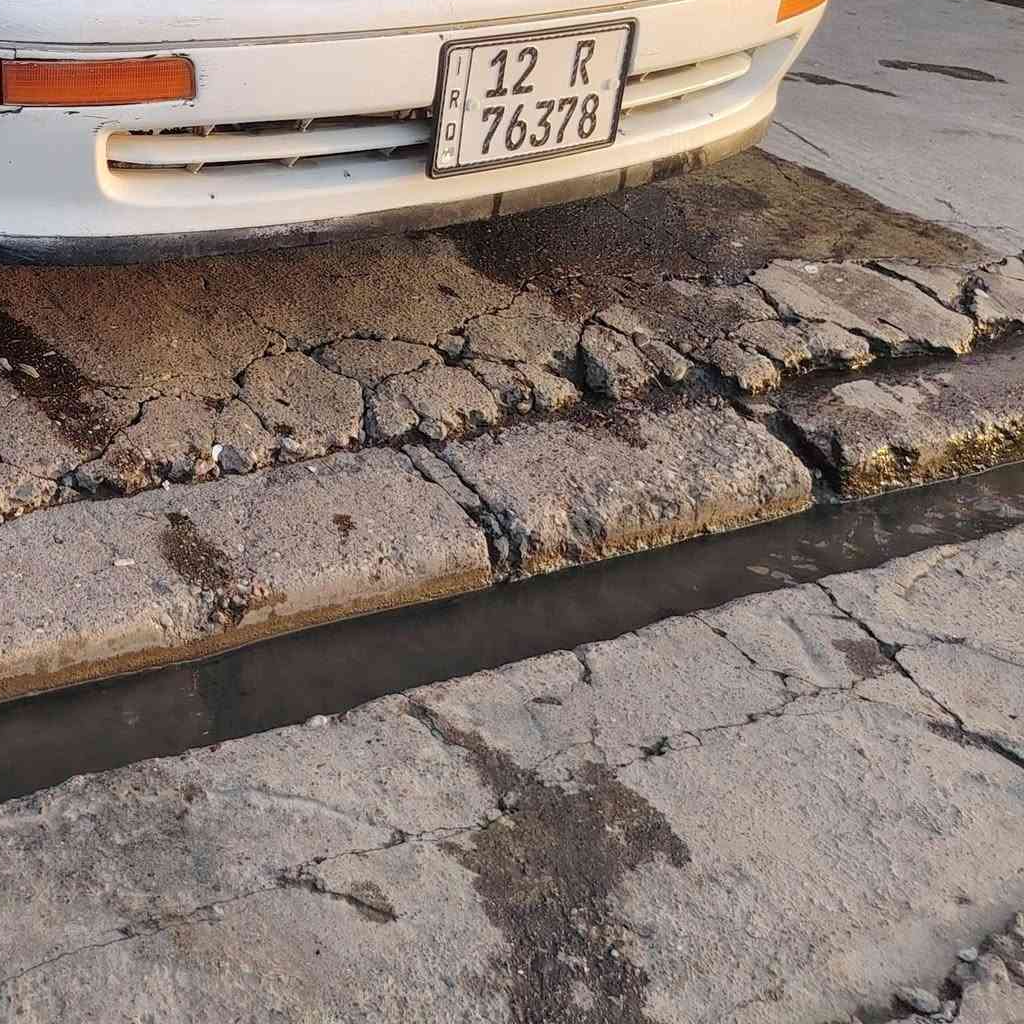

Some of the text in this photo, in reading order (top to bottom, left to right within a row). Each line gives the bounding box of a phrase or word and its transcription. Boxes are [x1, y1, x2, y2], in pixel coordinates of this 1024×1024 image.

[485, 39, 596, 98] 12 R
[481, 93, 600, 155] 76378
